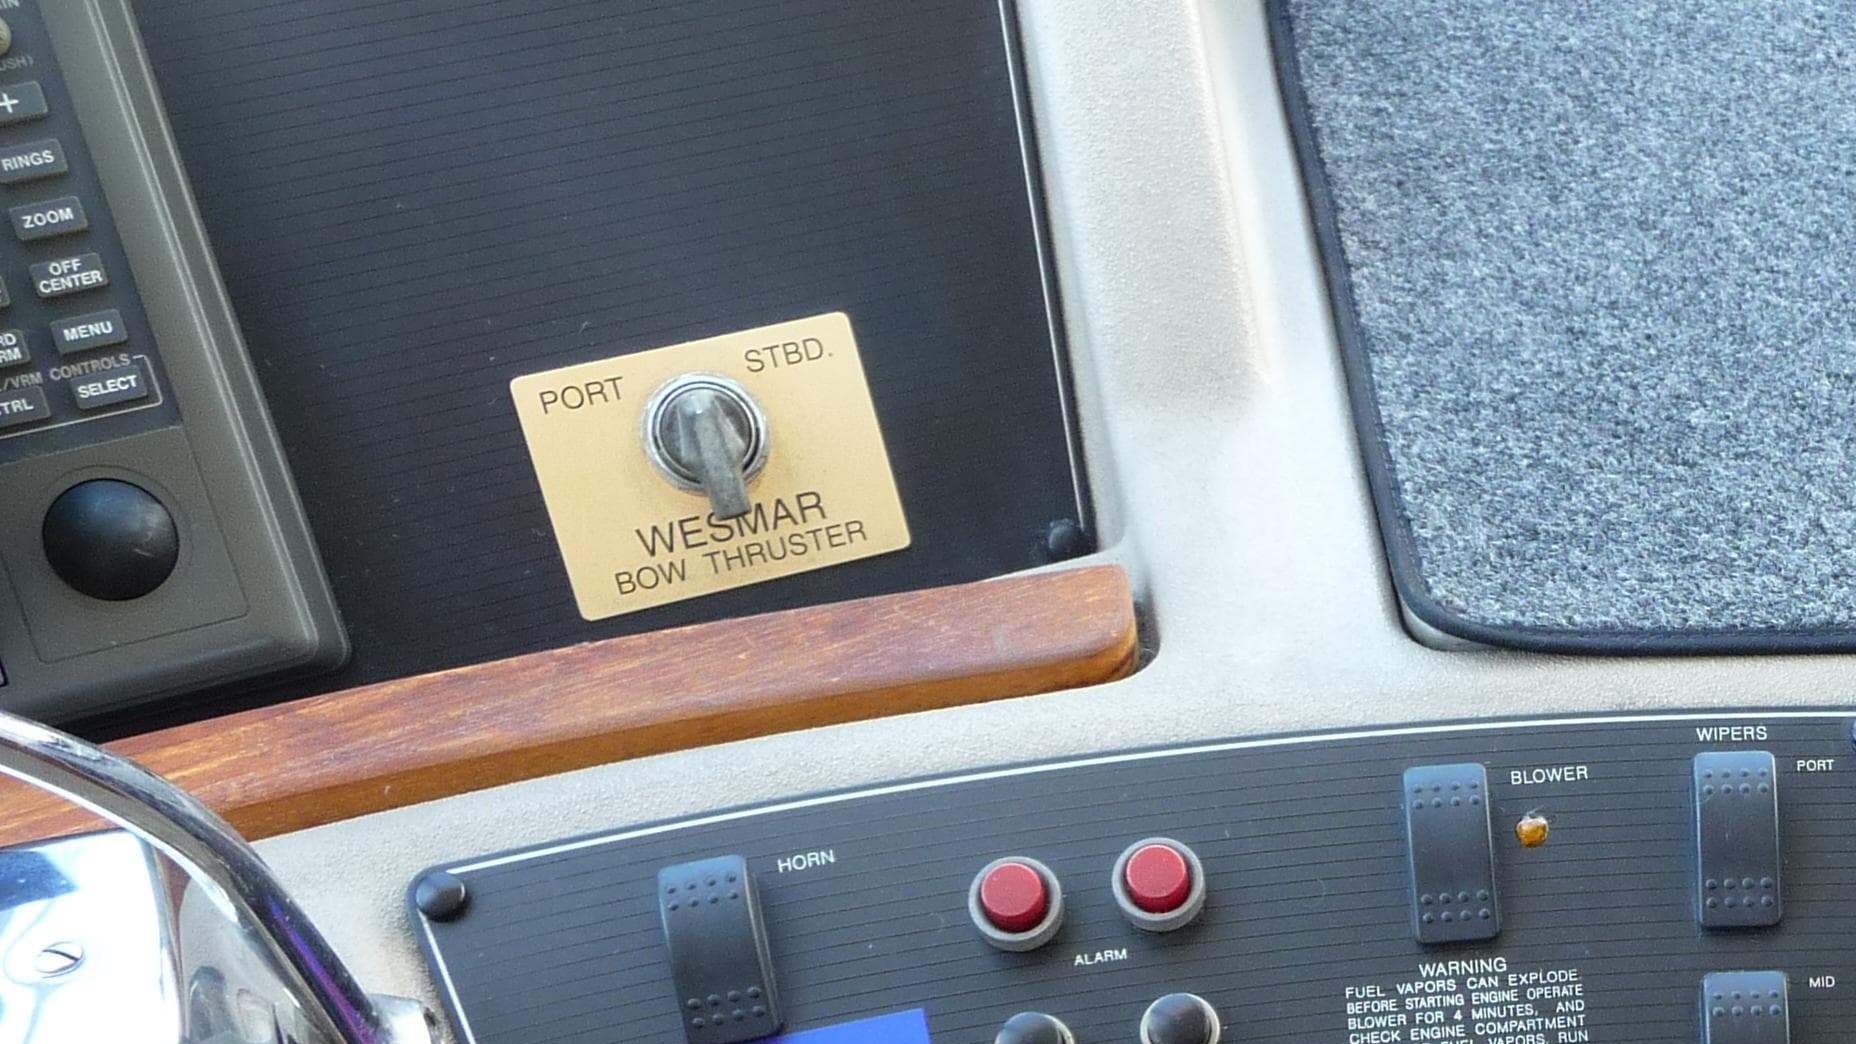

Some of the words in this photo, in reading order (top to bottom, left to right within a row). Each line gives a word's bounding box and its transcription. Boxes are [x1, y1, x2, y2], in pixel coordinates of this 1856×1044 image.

[2, 150, 55, 172] RINGS
[22, 208, 75, 229] ZOOM
[49, 258, 83, 276] OFF
[39, 270, 103, 294] CENTER
[63, 321, 113, 342] MENU
[50, 353, 131, 381] CONTROLS
[745, 337, 834, 373] STBD.
[78, 375, 138, 399] SELECT
[539, 376, 624, 414] PORT
[636, 491, 827, 558] WESMAR
[615, 559, 687, 595] BOW
[707, 520, 867, 576] THRUSTER
[1696, 725, 1768, 743] WIPERS
[1510, 766, 1588, 785] BLOWER
[1796, 758, 1834, 773] PORT
[777, 849, 836, 873] HORN
[1073, 948, 1129, 968] ALARM
[1418, 957, 1507, 978] WARNING
[1345, 985, 1386, 1000] FUEL
[1396, 979, 1456, 996] VAPORS
[1466, 975, 1500, 990] CAN
[1808, 976, 1836, 989] MID
[1347, 999, 1398, 1015] BEFORE
[1405, 994, 1465, 1011] STARTING
[1471, 989, 1519, 1005] ENGINE
[1526, 984, 1584, 1001] OPERATE
[1348, 1014, 1407, 1030] BLOWER
[1415, 1010, 1444, 1025] FOR
[1453, 1010, 1463, 1021] 4
[1555, 999, 1585, 1013] AND
[1410, 1024, 1465, 1041] ENGINE
[1475, 1014, 1586, 1036] COMPARTMENT
[1558, 1029, 1589, 1044] RUN
